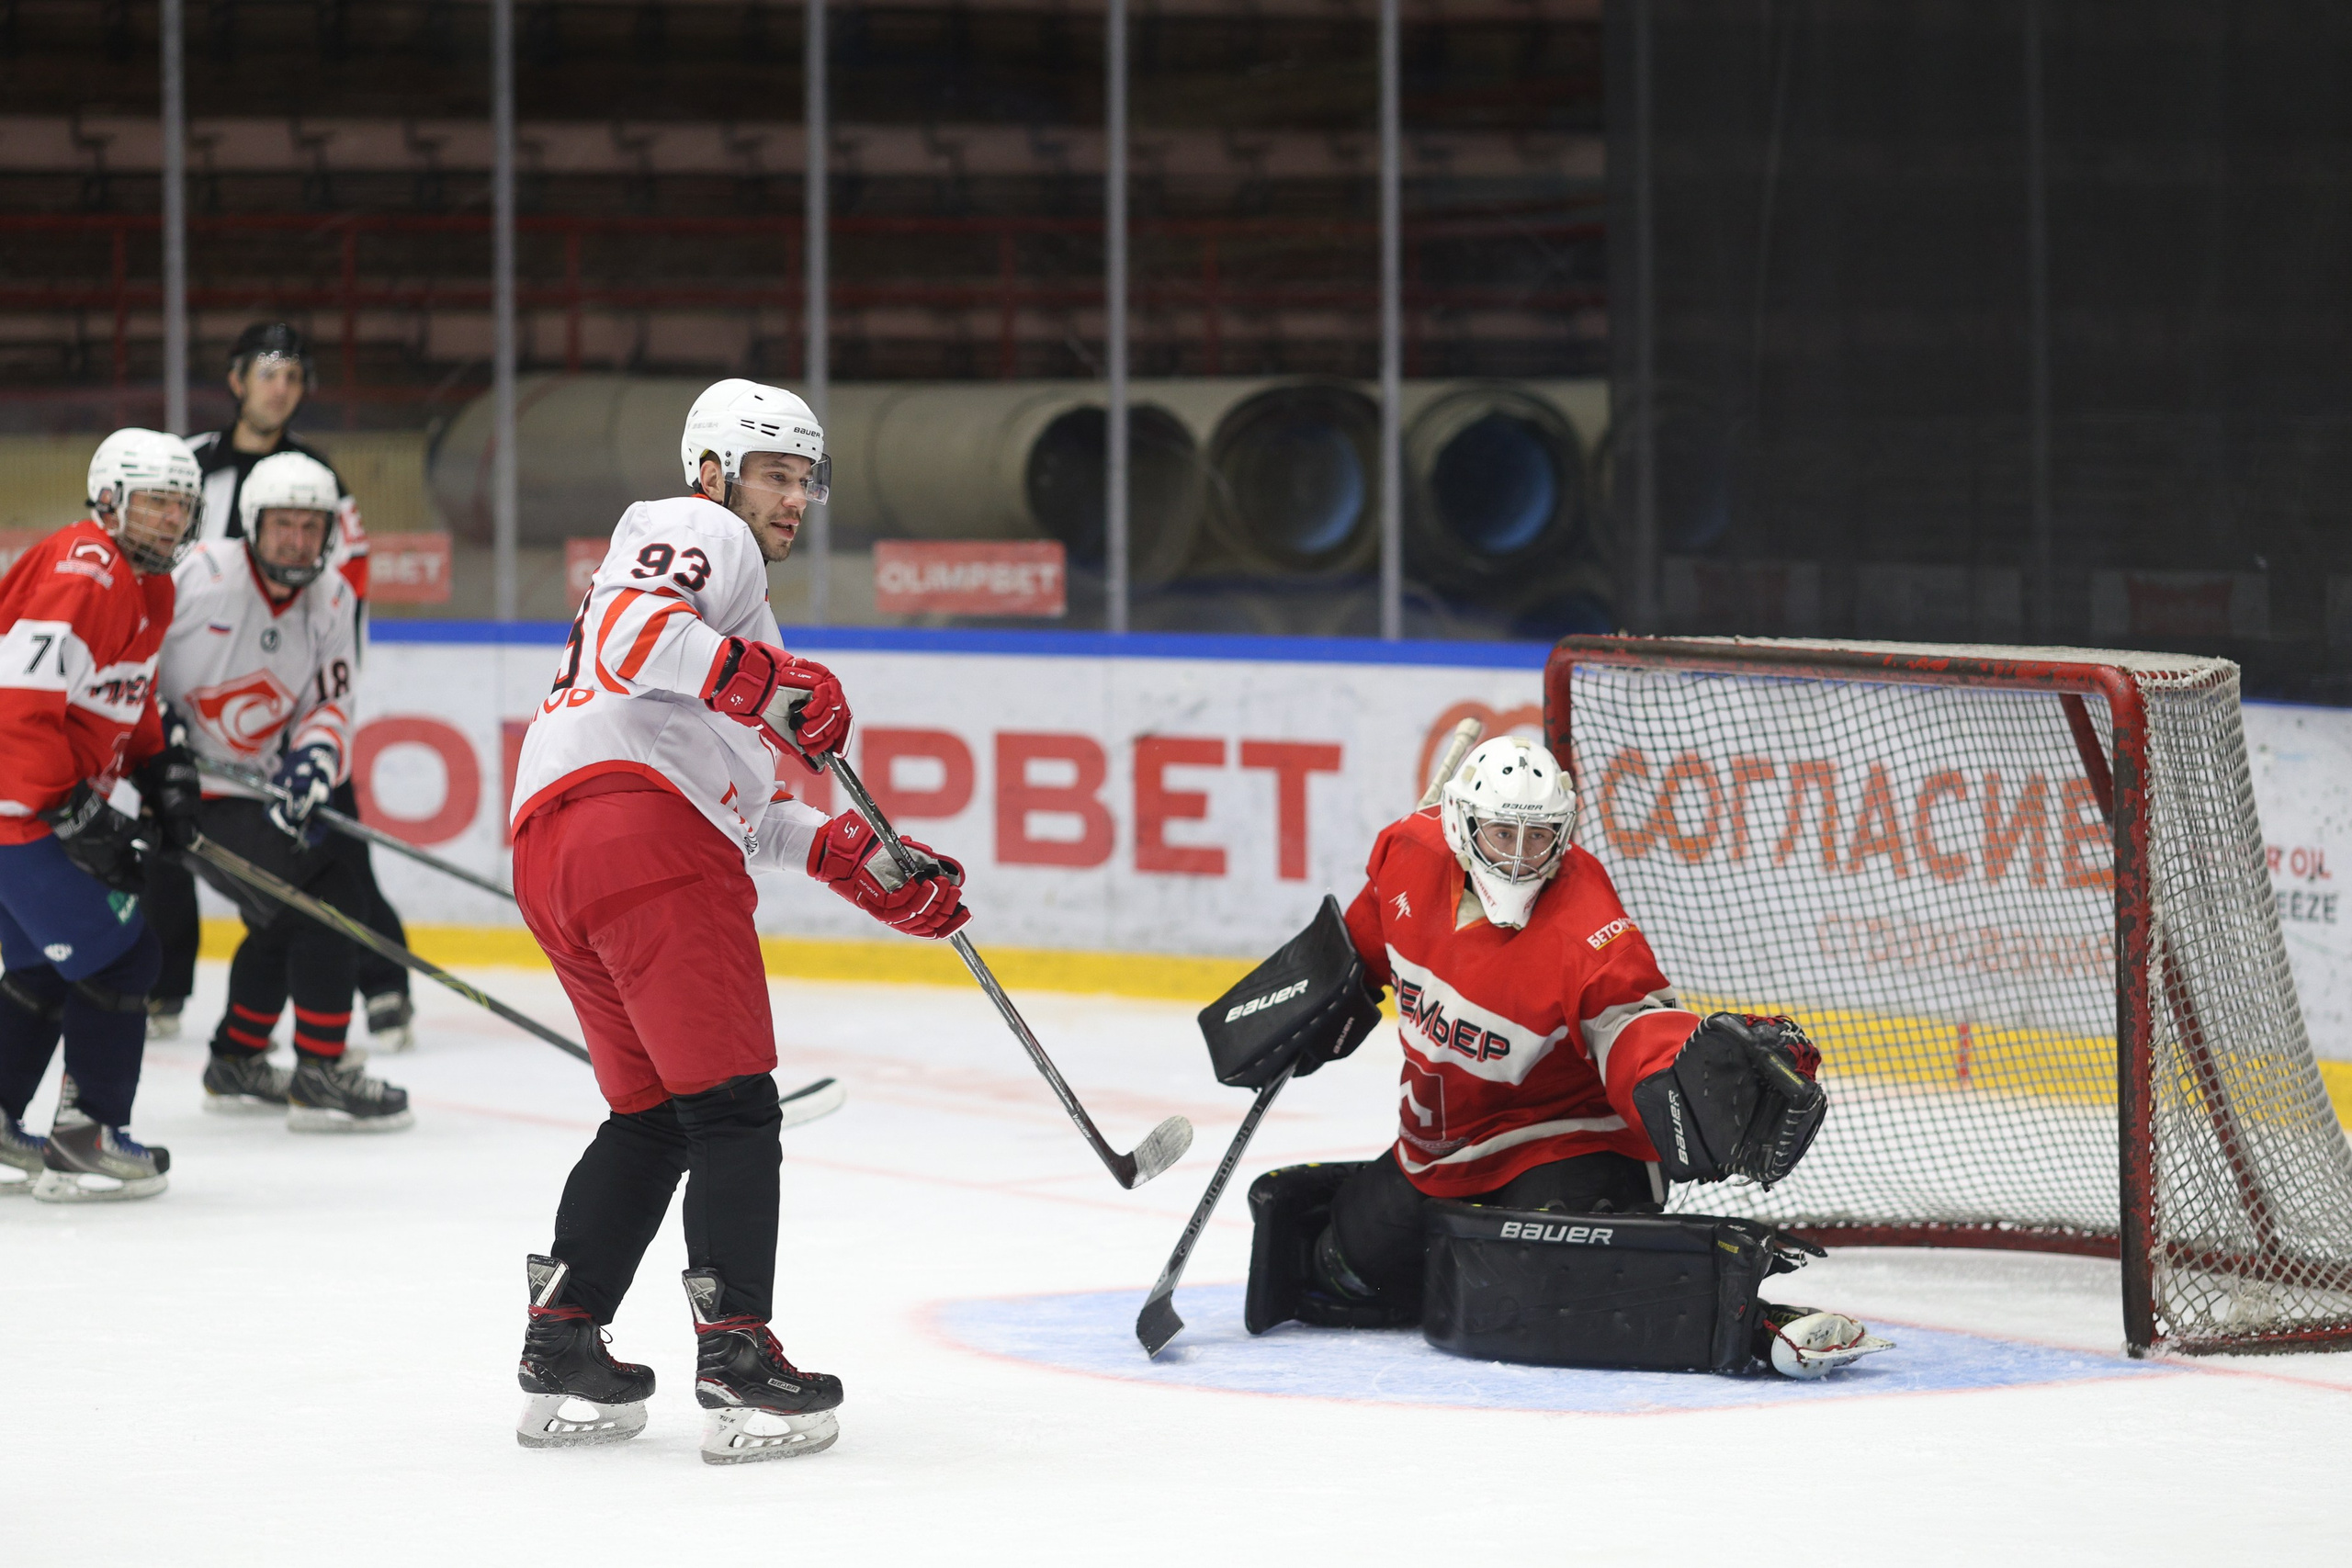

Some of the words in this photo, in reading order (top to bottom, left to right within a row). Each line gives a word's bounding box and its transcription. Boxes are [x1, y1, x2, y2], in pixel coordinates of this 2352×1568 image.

[793, 426, 821, 438] BAUER
[630, 543, 711, 592] 93
[316, 659, 348, 703] 18
[351, 712, 1342, 881] OPBET
[1501, 802, 1544, 811] BAUER
[1598, 747, 2115, 891] СОГЛАСИЕ
[1225, 978, 1309, 1023] BAUER
[1668, 1089, 1689, 1166] BAUER
[1500, 1221, 1613, 1246] BAUER
